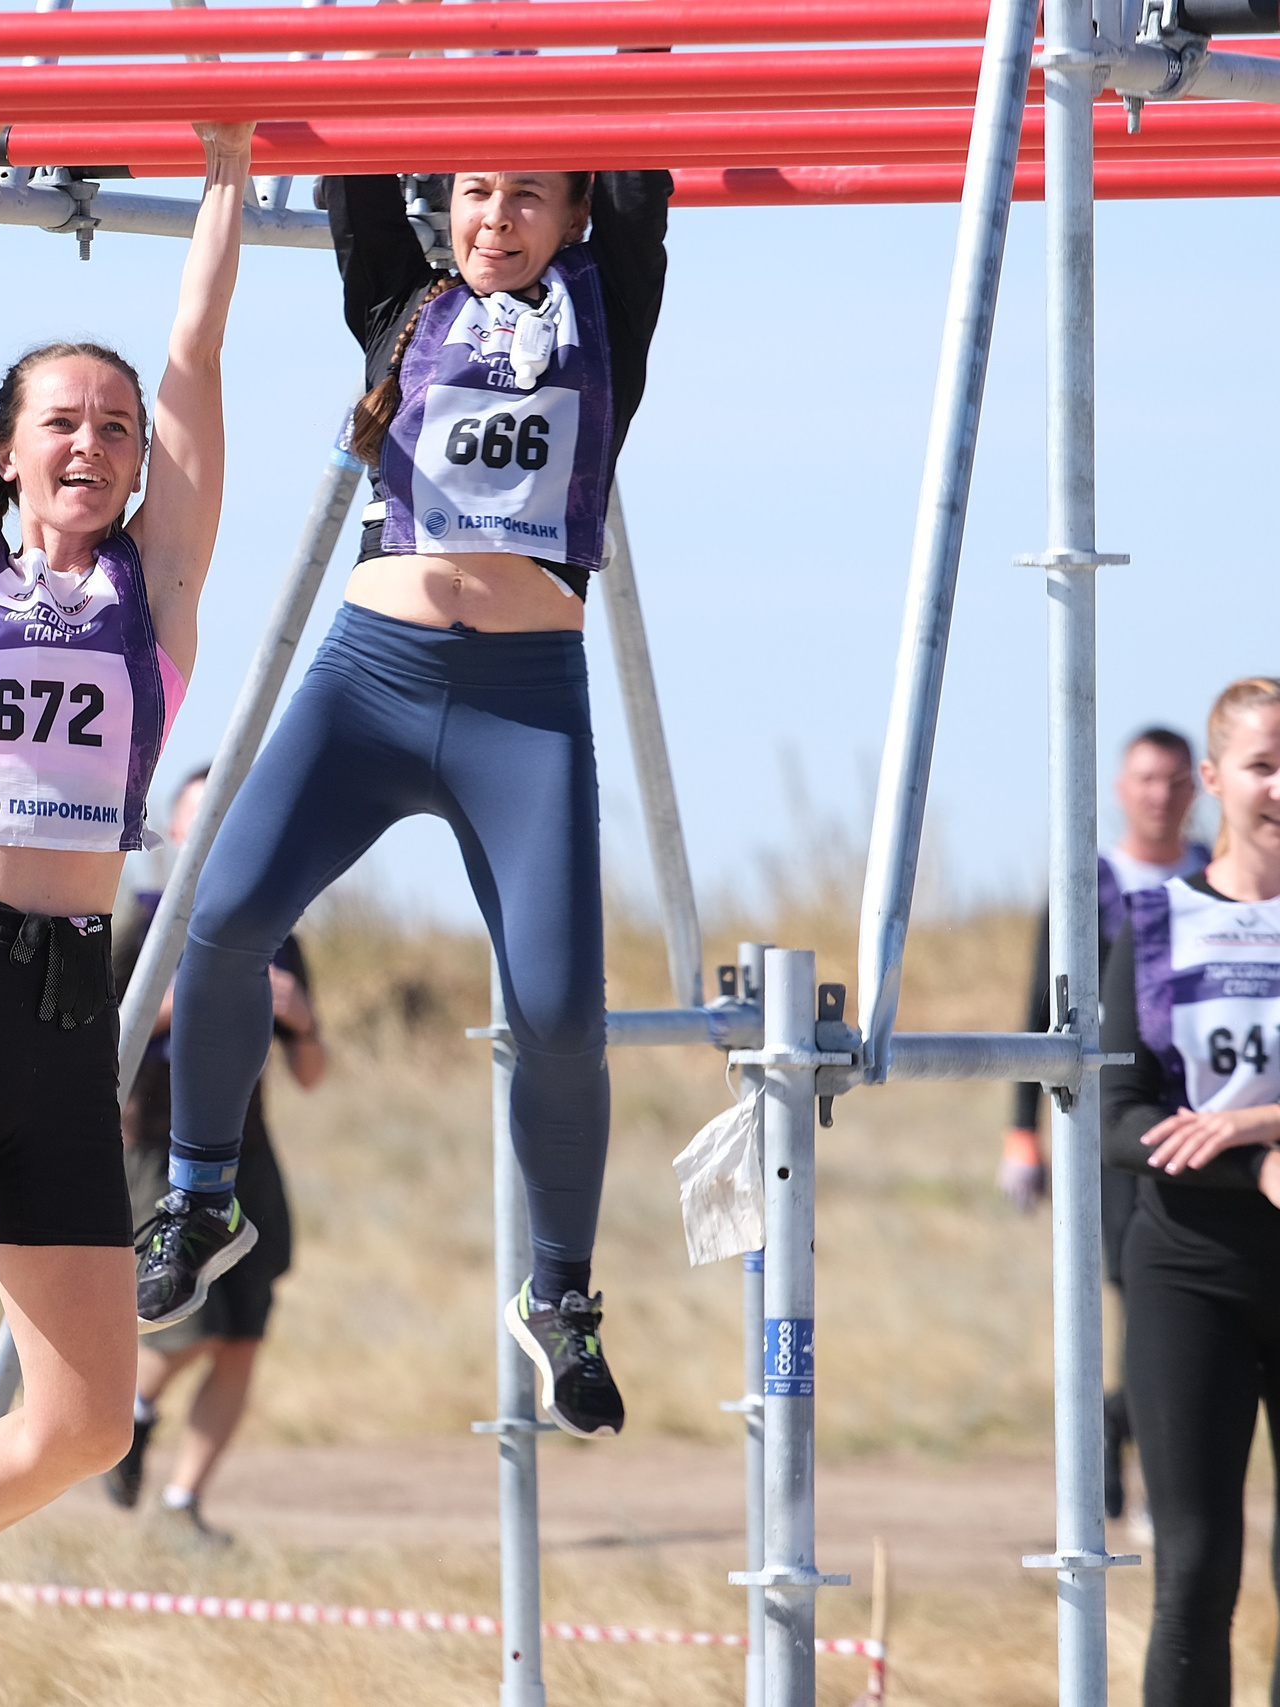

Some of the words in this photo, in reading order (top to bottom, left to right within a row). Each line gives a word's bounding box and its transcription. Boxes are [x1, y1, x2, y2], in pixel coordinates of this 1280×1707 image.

[486, 370, 518, 389] СТА
[445, 412, 549, 470] 666
[457, 514, 559, 540] ГАЗПРОМБАНК
[23, 622, 73, 643] СТАРТ
[9, 799, 118, 824] ГАЗПРОМБАНК
[1208, 1025, 1280, 1075] 64
